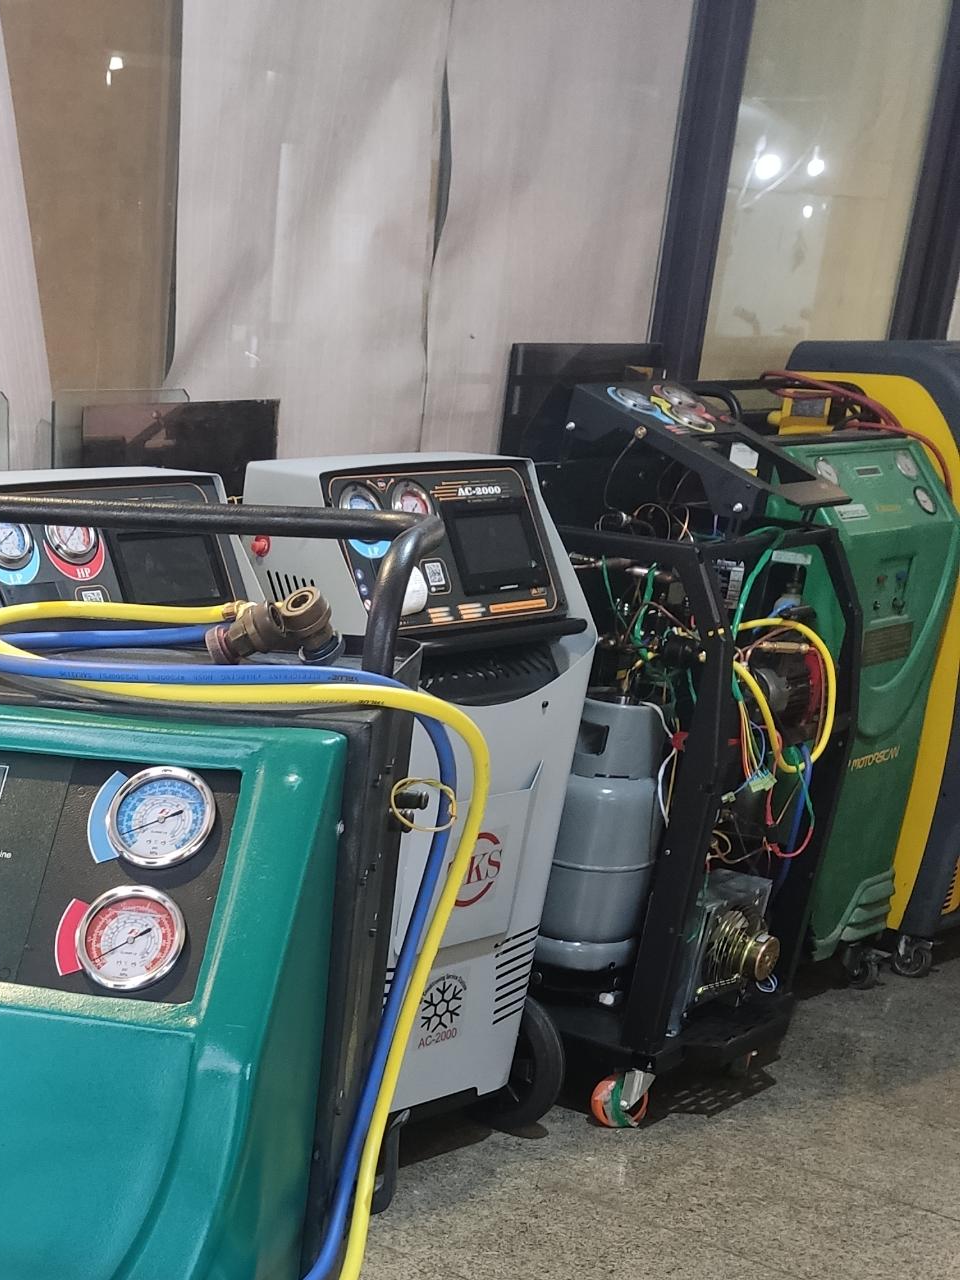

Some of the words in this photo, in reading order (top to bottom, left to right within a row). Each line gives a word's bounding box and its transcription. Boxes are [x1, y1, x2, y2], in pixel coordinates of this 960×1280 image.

[457, 485, 502, 497] AC-2000
[76, 567, 91, 579] HP
[447, 848, 503, 887] KS
[418, 1027, 458, 1049] AC-2000
